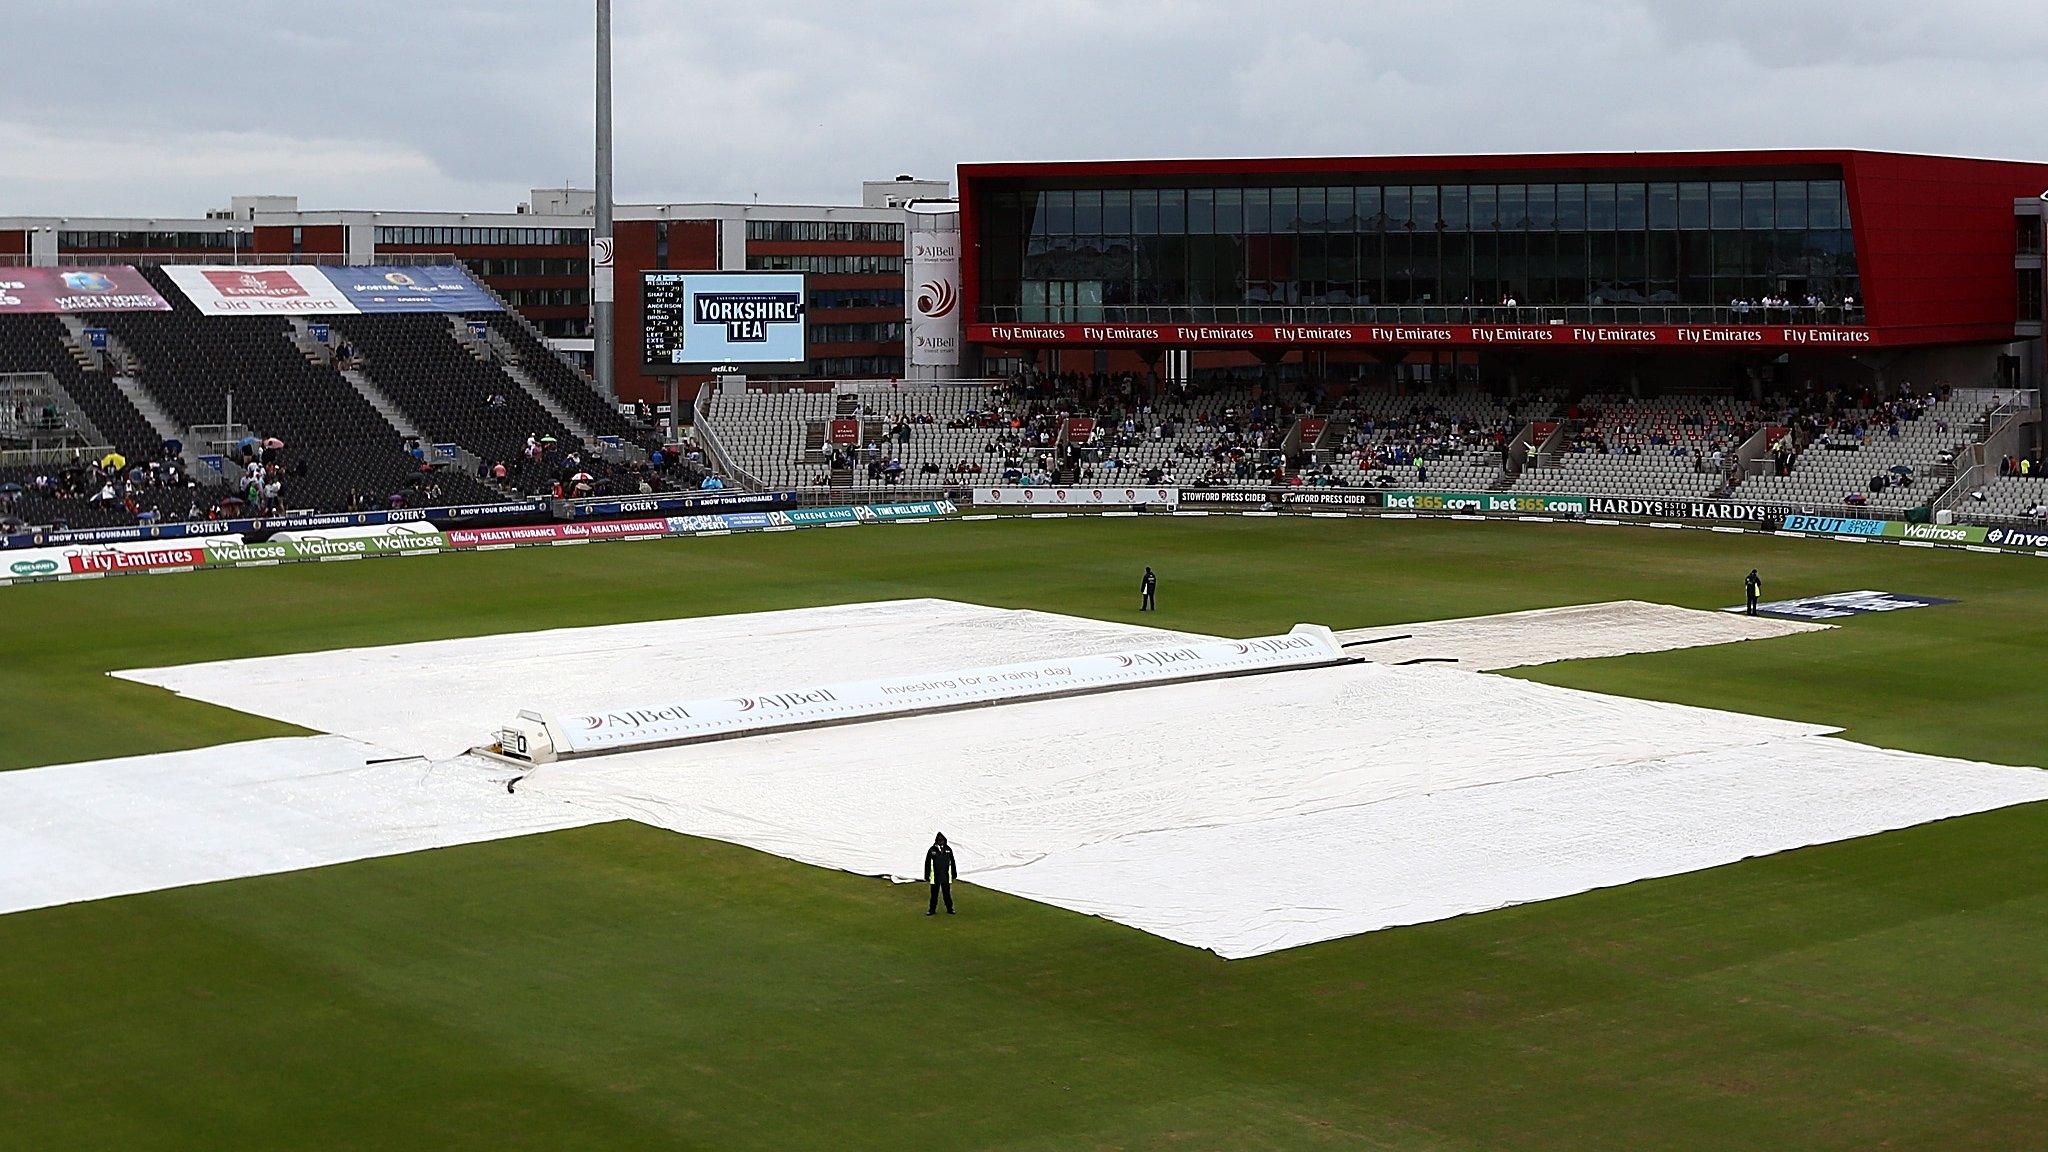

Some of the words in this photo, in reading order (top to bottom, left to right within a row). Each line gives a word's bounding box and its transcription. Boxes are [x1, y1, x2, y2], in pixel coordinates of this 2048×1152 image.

[924, 246, 954, 258] AJBell
[226, 286, 298, 296] Emirates
[214, 299, 251, 310] Old
[258, 299, 337, 310] Trafford
[731, 321, 763, 338] TEA
[992, 328, 1011, 340] Fly
[1014, 327, 1066, 339] Emirates
[1083, 328, 1104, 340] Fly
[1106, 327, 1159, 339] Emirates
[1177, 328, 1198, 341] Fly
[1201, 327, 1254, 339] Emirates
[1274, 328, 1295, 341] Fly
[1298, 327, 1352, 339] Emirates
[1372, 328, 1393, 341] Fly
[1396, 327, 1451, 340] Emirates
[1472, 328, 1493, 342] Fly
[1496, 327, 1553, 340] Emirates
[1573, 328, 1595, 342] Fly
[1599, 328, 1656, 341] Emirates
[1677, 328, 1700, 342] Fly
[1703, 328, 1762, 341] Emirates
[1783, 329, 1806, 343] Fly
[1810, 329, 1870, 342] Emirates
[924, 337, 954, 348] AJBell
[711, 365, 739, 373] adi.tv
[701, 498, 719, 506] KNOW
[738, 495, 774, 503] BOUNDARIES
[1182, 492, 1220, 502] STOWFORD
[1221, 493, 1243, 502] PRESS
[1245, 493, 1266, 502] CIDER
[1320, 494, 1342, 503] PRESS
[1344, 495, 1366, 504] CIDER
[1387, 494, 1481, 510] bet365.com
[499, 504, 536, 513] BOUNDARIES
[620, 501, 659, 512] FOSTER'S
[876, 506, 893, 516] TIME
[894, 505, 911, 515] WELL
[911, 504, 933, 513] SPENT
[934, 500, 958, 515] IPA
[1489, 498, 1583, 512] bet365.com
[1589, 499, 1663, 515] HARDYS
[1664, 502, 1687, 510] ESTD
[1691, 503, 1765, 521] HARDYS
[1767, 506, 1790, 515] ESTD
[387, 510, 427, 521] FOSTER'S
[766, 511, 793, 526] IPA
[793, 512, 828, 521] GREENE
[829, 510, 852, 519] KING
[852, 505, 877, 520] IPA
[1664, 510, 1687, 518] 1853
[185, 522, 229, 534] FOSTER'S
[265, 520, 287, 528] KNOW
[309, 516, 349, 525] BOUNDARIES
[1790, 516, 1847, 532] BRUT
[1849, 520, 1880, 528] SPORT
[49, 533, 72, 542] KNOW
[73, 532, 95, 540] YOUR
[96, 529, 141, 539] BOUNDARIES
[451, 531, 479, 544] Vitality
[480, 531, 511, 541] HEALTH
[511, 528, 557, 539] INSURANCE
[562, 524, 590, 537] Vitality
[591, 525, 620, 534] HEALTH
[621, 522, 664, 532] INSURANCE
[1846, 526, 1877, 535] STYLE
[1903, 524, 1967, 541] Waitrose
[293, 539, 366, 555] Waitrose
[372, 534, 443, 550] Waitrose
[81, 556, 112, 570] Fly
[117, 549, 193, 567] Emirates
[210, 544, 286, 561] Waitrose
[1250, 637, 1315, 654] AJBell
[1135, 649, 1202, 666] AJBell
[881, 678, 957, 695] Investing
[959, 675, 981, 685] for
[987, 674, 998, 682] a
[1002, 669, 1040, 681] rainy
[1044, 665, 1072, 677] day
[758, 689, 839, 709] AJBell
[607, 706, 691, 728] AJBell
